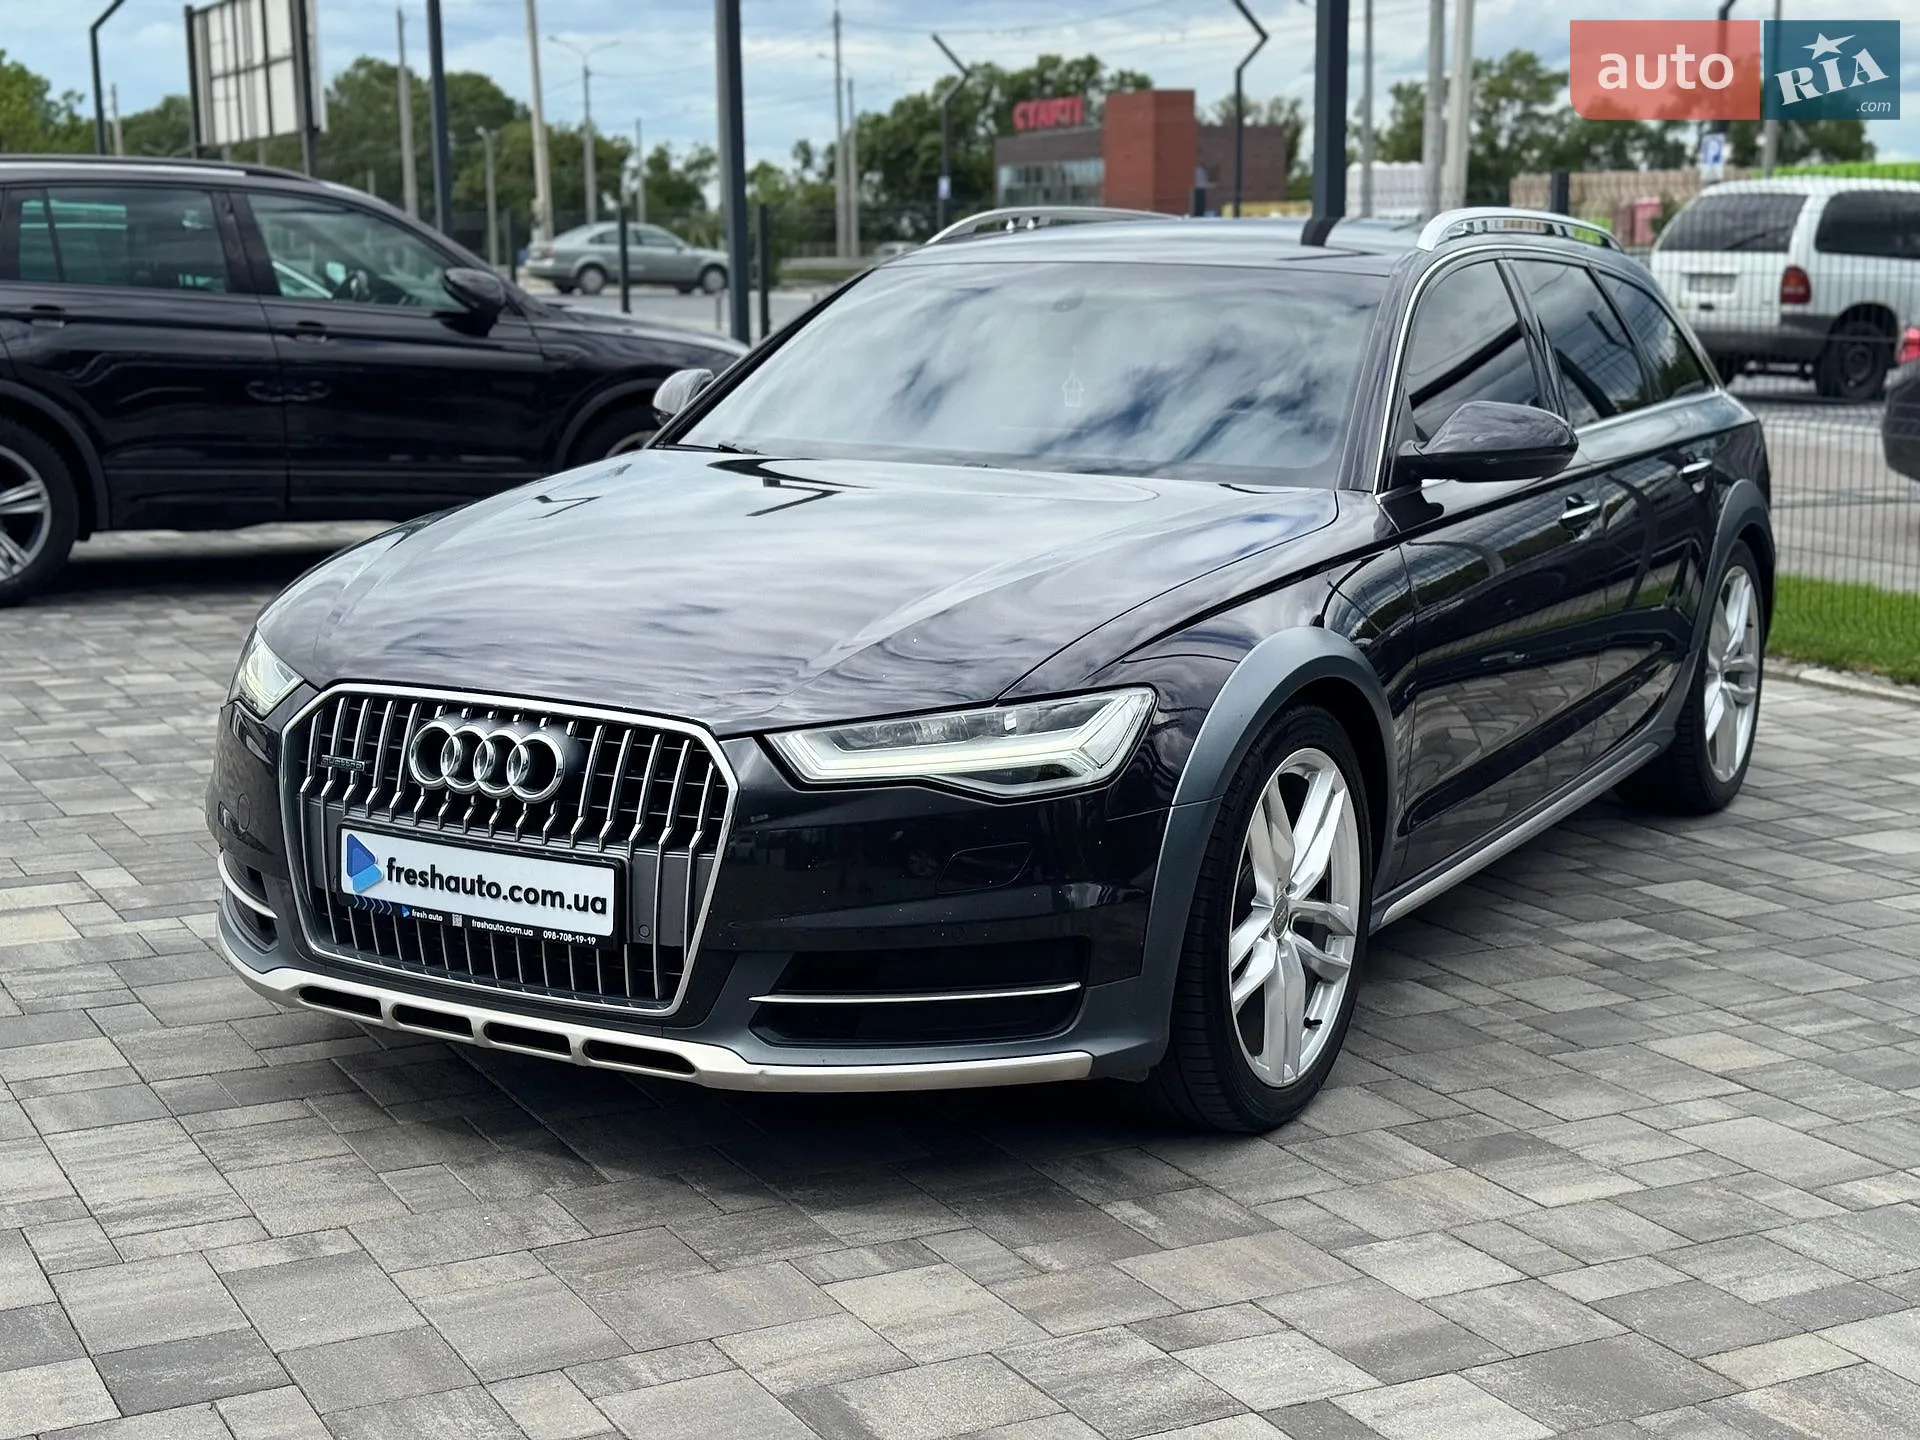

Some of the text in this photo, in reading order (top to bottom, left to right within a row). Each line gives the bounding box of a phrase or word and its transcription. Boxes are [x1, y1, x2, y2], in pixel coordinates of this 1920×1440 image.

[386, 857, 607, 915] freshauto.com.ua
[411, 908, 443, 922] fresh auto
[471, 919, 533, 936] freshauto.com.ua
[543, 930, 596, 945] 098-708-19-19
